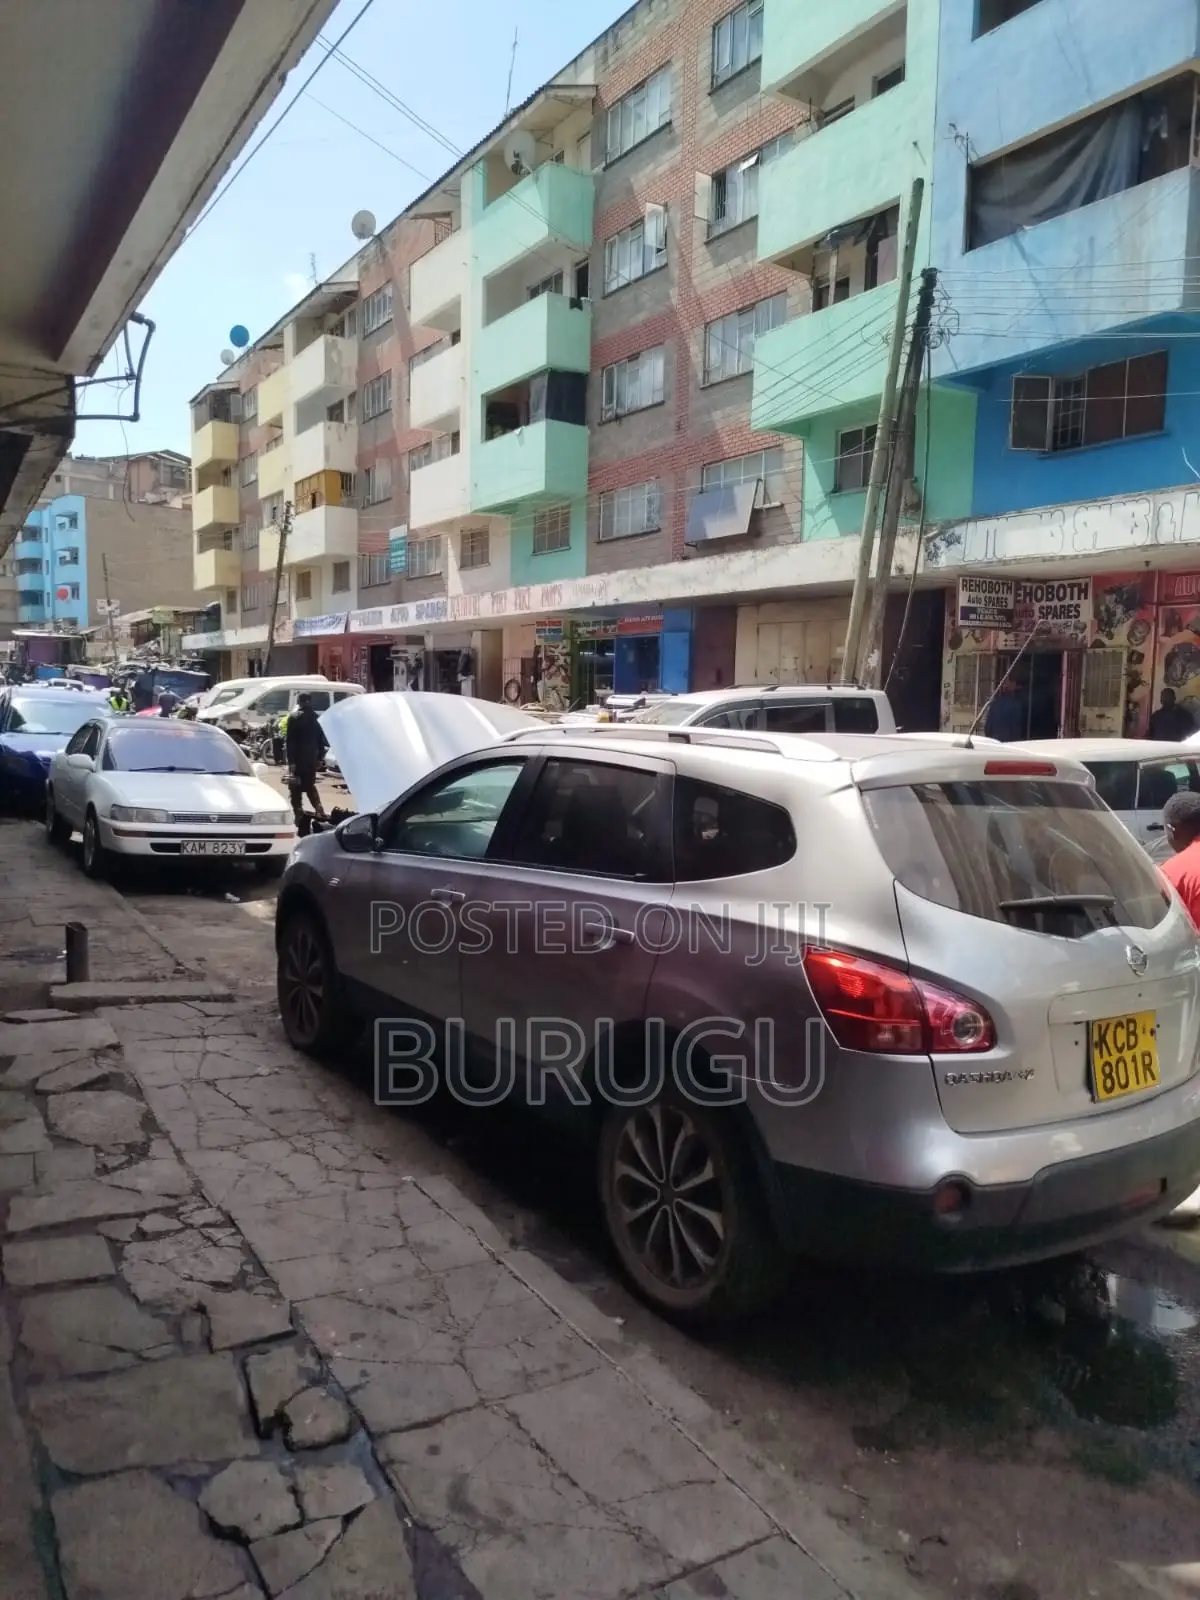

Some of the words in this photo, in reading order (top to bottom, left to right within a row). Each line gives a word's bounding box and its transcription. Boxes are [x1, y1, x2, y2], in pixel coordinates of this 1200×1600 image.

[961, 579, 1013, 595] REHOBOTH
[1015, 582, 1089, 604] EHOBOTH
[1174, 575, 1200, 596] AUT
[967, 594, 982, 605] Auto
[983, 595, 1009, 609] SPARES
[1038, 603, 1081, 620] SPARES
[182, 842, 206, 854] KAM
[212, 842, 245, 854] 823Y
[1098, 1018, 1139, 1059] KCB
[1101, 1050, 1156, 1095] 801R
